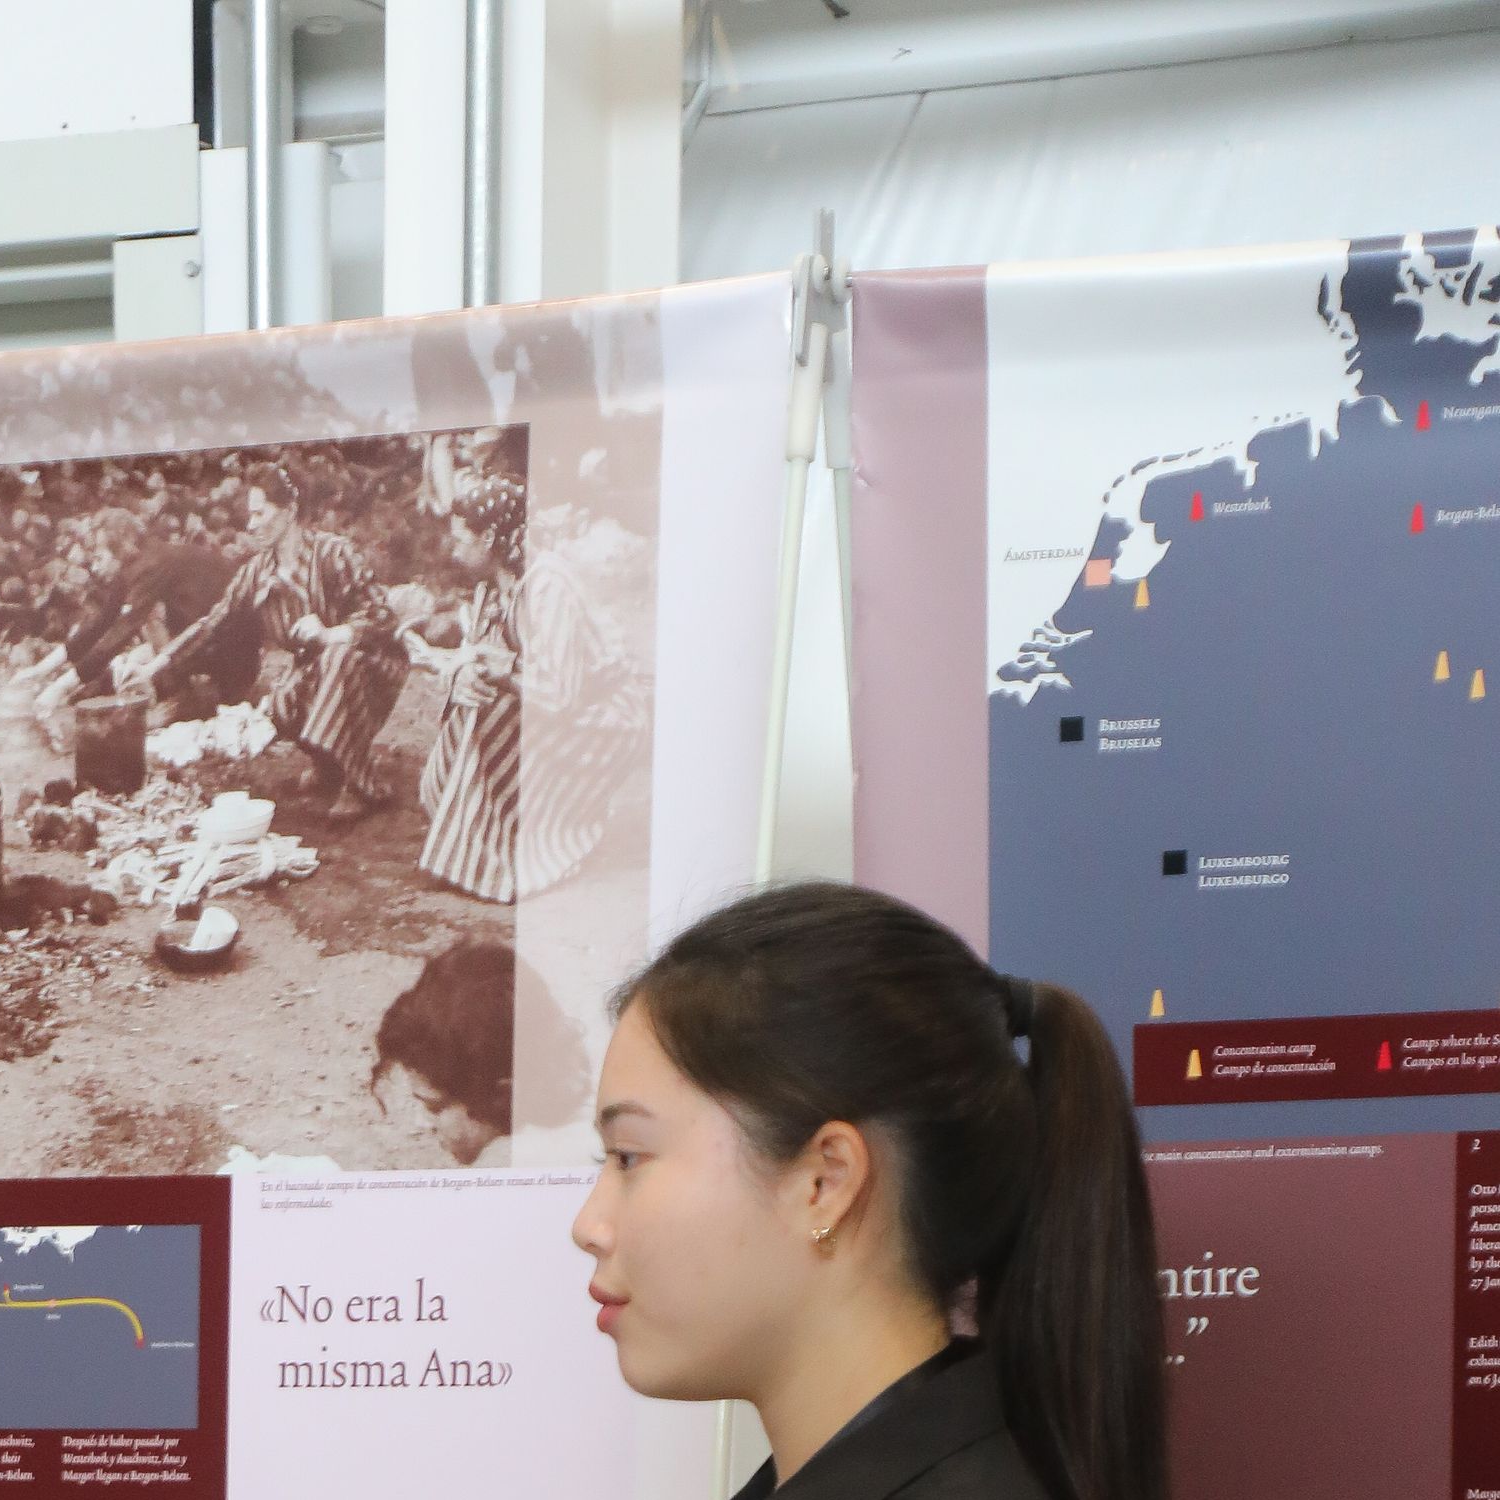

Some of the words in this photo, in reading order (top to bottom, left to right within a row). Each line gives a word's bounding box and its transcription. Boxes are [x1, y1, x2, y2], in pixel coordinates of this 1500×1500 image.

[1212, 496, 1273, 515] Westerbork
[1099, 718, 1160, 731] BRUSSELS
[1099, 737, 1161, 750] BRUSELAS
[1198, 855, 1289, 868] LUXEMBOURG
[1197, 874, 1289, 888] LUXEMBURGO
[1158, 1250, 1261, 1299] ntire
[260, 1284, 333, 1323] «No
[345, 1295, 403, 1322] era
[415, 1277, 448, 1321] la
[278, 1345, 410, 1388] misma
[418, 1348, 512, 1387] Ana»
